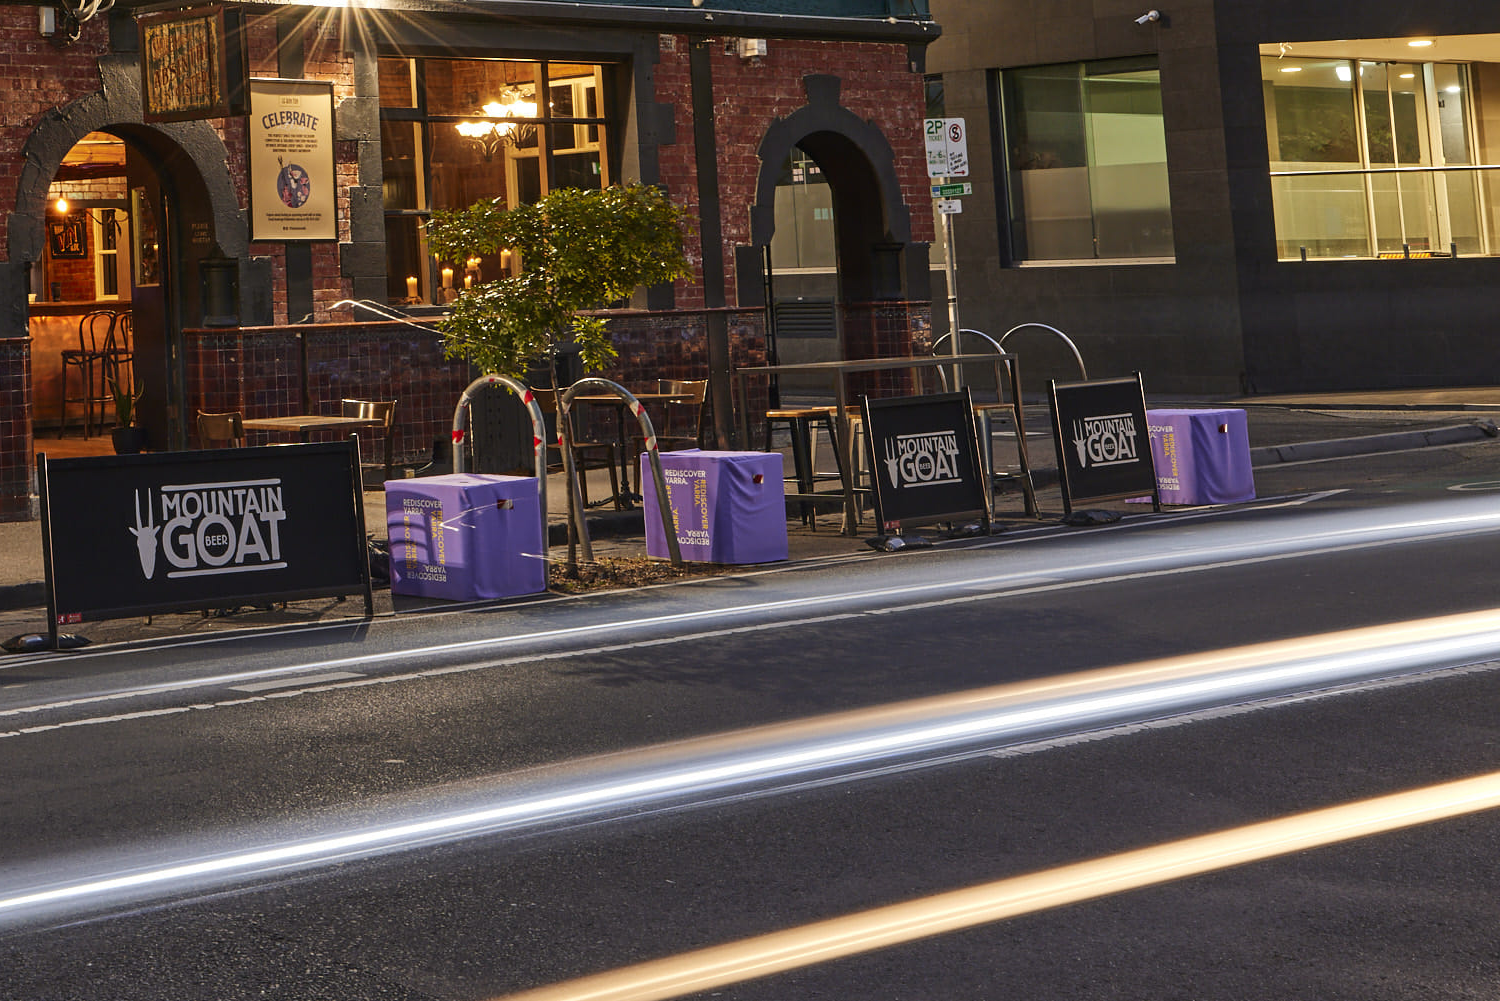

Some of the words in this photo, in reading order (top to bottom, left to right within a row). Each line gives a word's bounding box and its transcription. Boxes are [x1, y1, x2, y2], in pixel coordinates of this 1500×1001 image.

[262, 110, 319, 131] CELEBRATE
[926, 120, 943, 135] 2P
[1084, 417, 1135, 437] MOUNTAIN
[897, 434, 956, 456] MOUNTAIN
[1087, 430, 1137, 462] GOAT
[665, 469, 706, 478] REDISCOVER
[900, 449, 960, 482] GOAT
[161, 486, 283, 521] MOUNTAIN
[403, 498, 443, 509] REDISCOVER
[700, 479, 709, 529] REDISCOVER
[162, 510, 287, 568] GOAT
[205, 534, 228, 546] BEER
